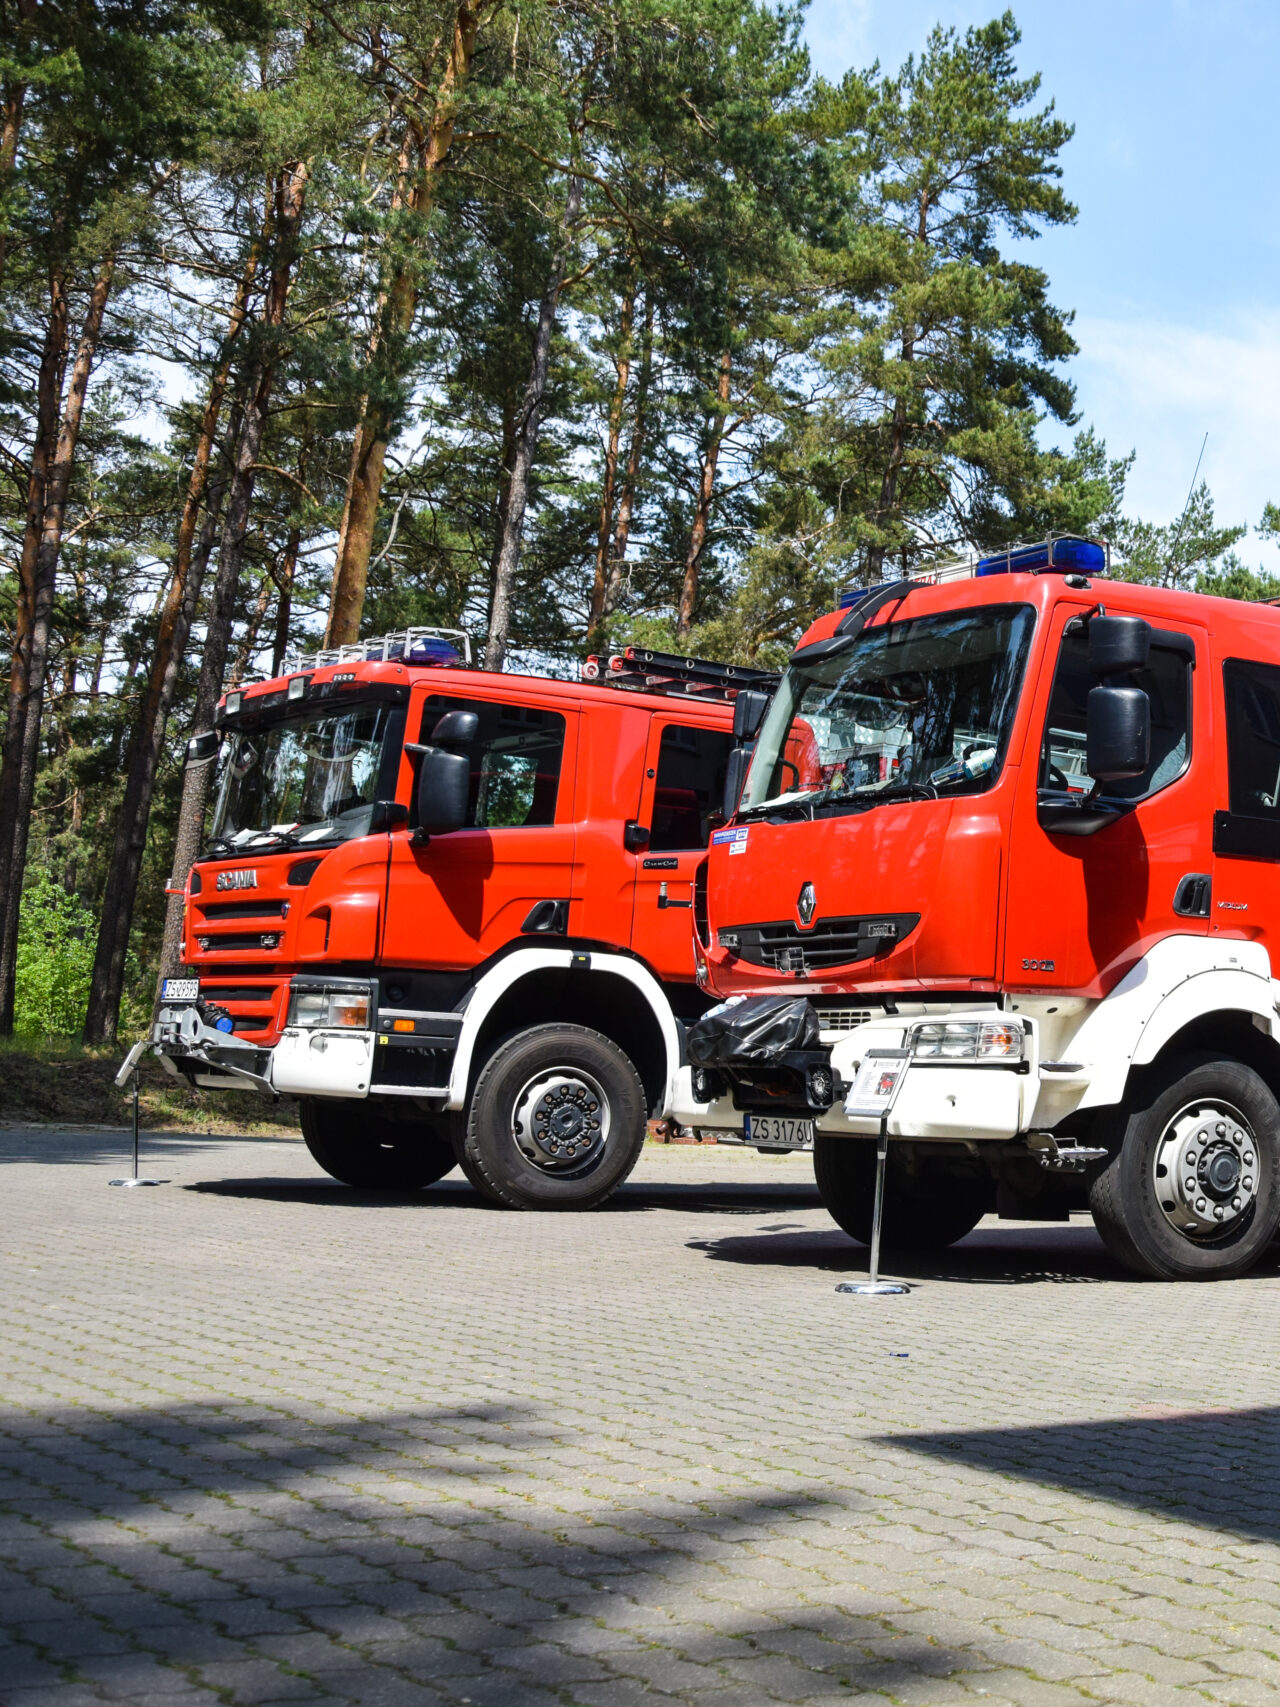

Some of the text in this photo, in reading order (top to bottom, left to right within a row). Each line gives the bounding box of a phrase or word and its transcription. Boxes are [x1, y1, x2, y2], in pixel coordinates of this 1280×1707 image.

[216, 869, 257, 890] SCANIA
[752, 1118, 769, 1139] ZS
[773, 1119, 812, 1143] 3176U
